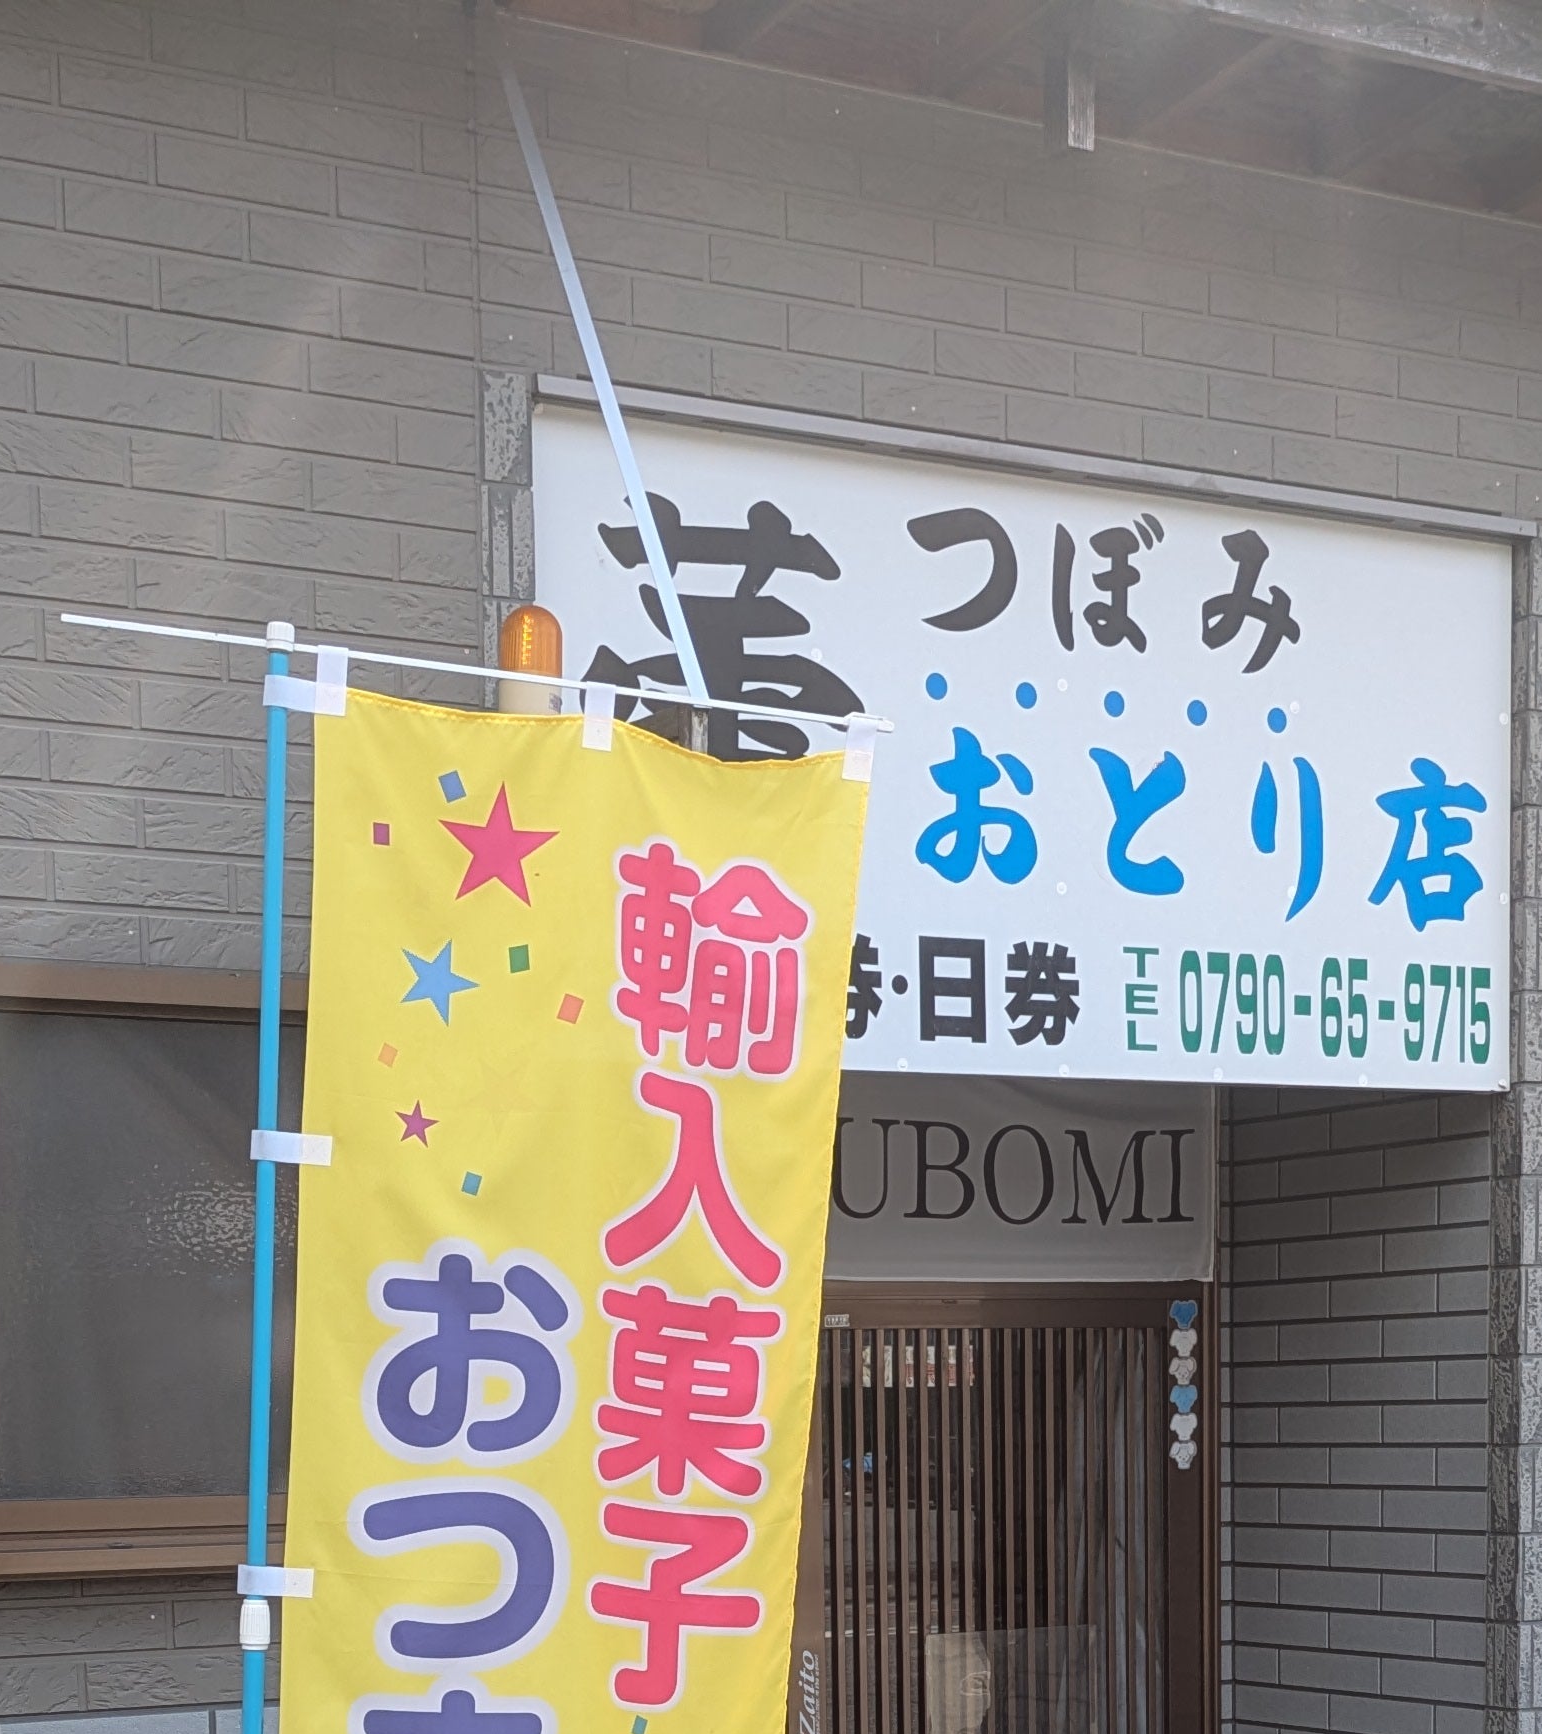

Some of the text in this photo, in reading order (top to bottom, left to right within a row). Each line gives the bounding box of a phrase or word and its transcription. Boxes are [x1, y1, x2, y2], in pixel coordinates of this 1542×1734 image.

[907, 507, 1301, 673] つぼみ
[915, 726, 1489, 933] おとり店
[1123, 946, 1492, 1064] TEL 0790-65-9715
[588, 843, 809, 1705] 輸入菓子
